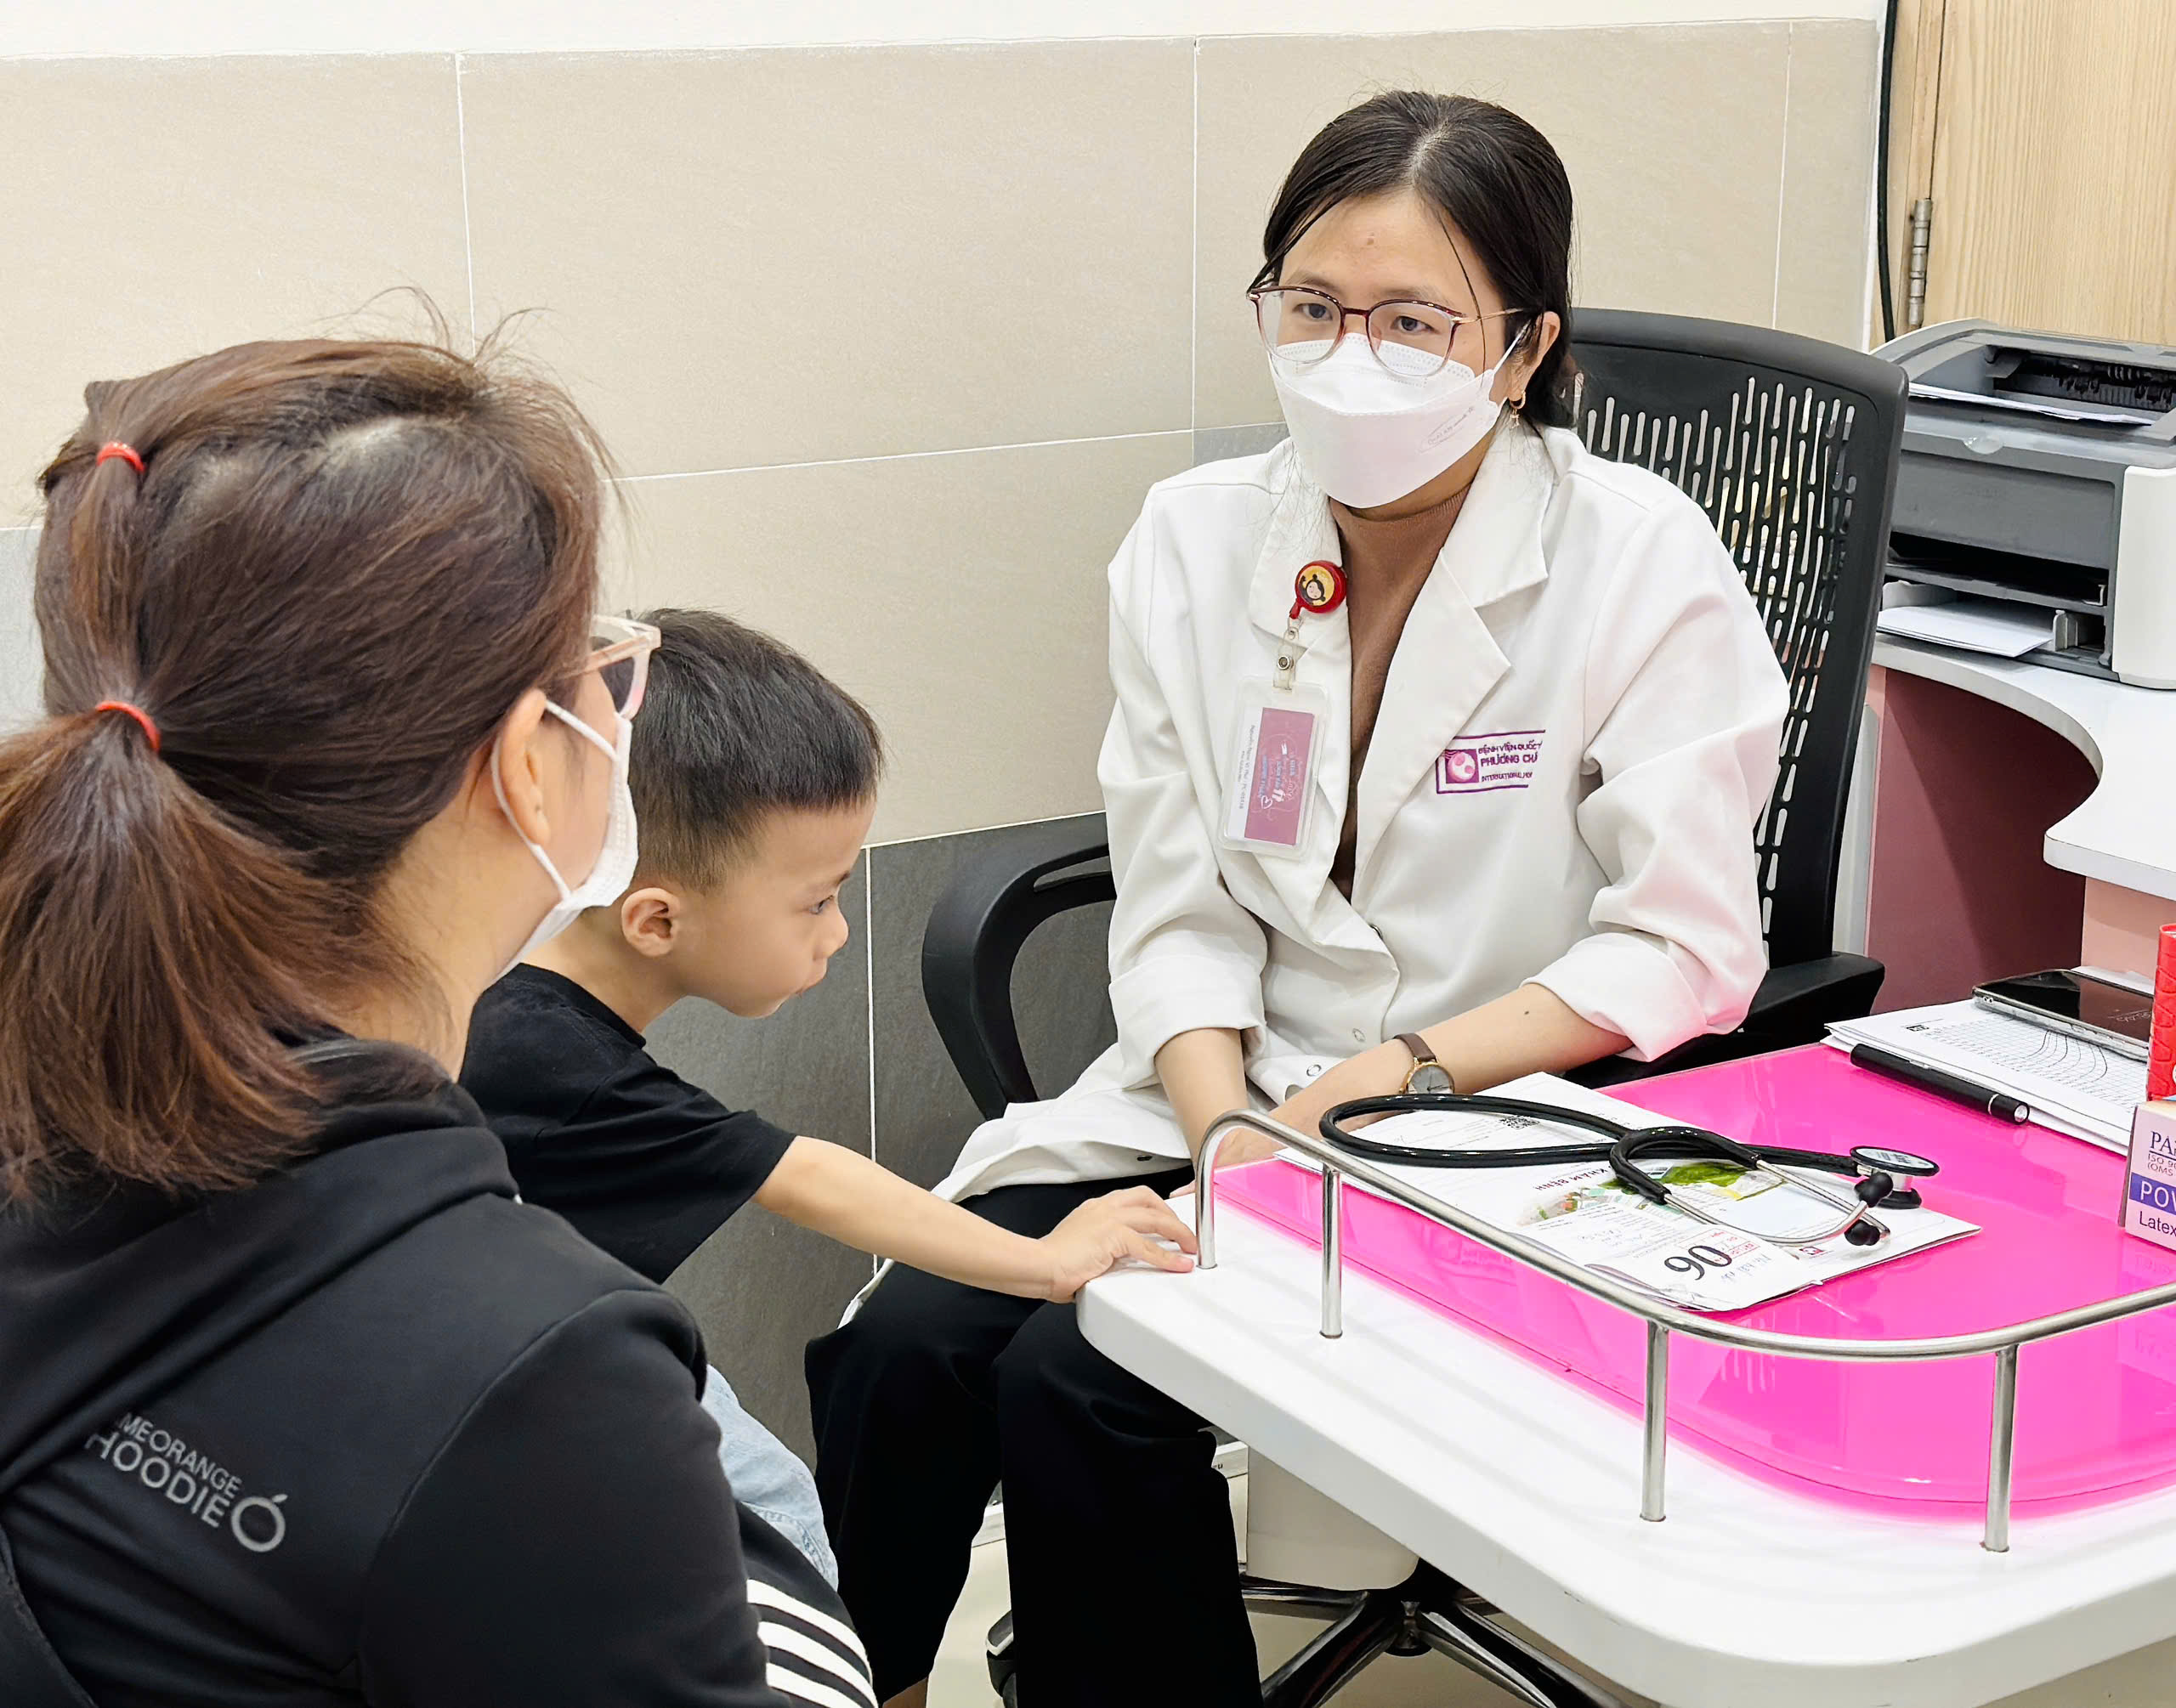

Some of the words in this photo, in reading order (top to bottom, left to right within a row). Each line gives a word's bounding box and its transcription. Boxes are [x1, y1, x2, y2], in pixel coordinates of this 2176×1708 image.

[1481, 753, 1520, 766] PHƯƠNG
[2150, 1130, 2176, 1157] PA
[2148, 1153, 2164, 1165] ISO
[2139, 1211, 2176, 1236] Latex
[118, 1412, 243, 1499] MEORANGE
[84, 1432, 230, 1528] HOODIE
